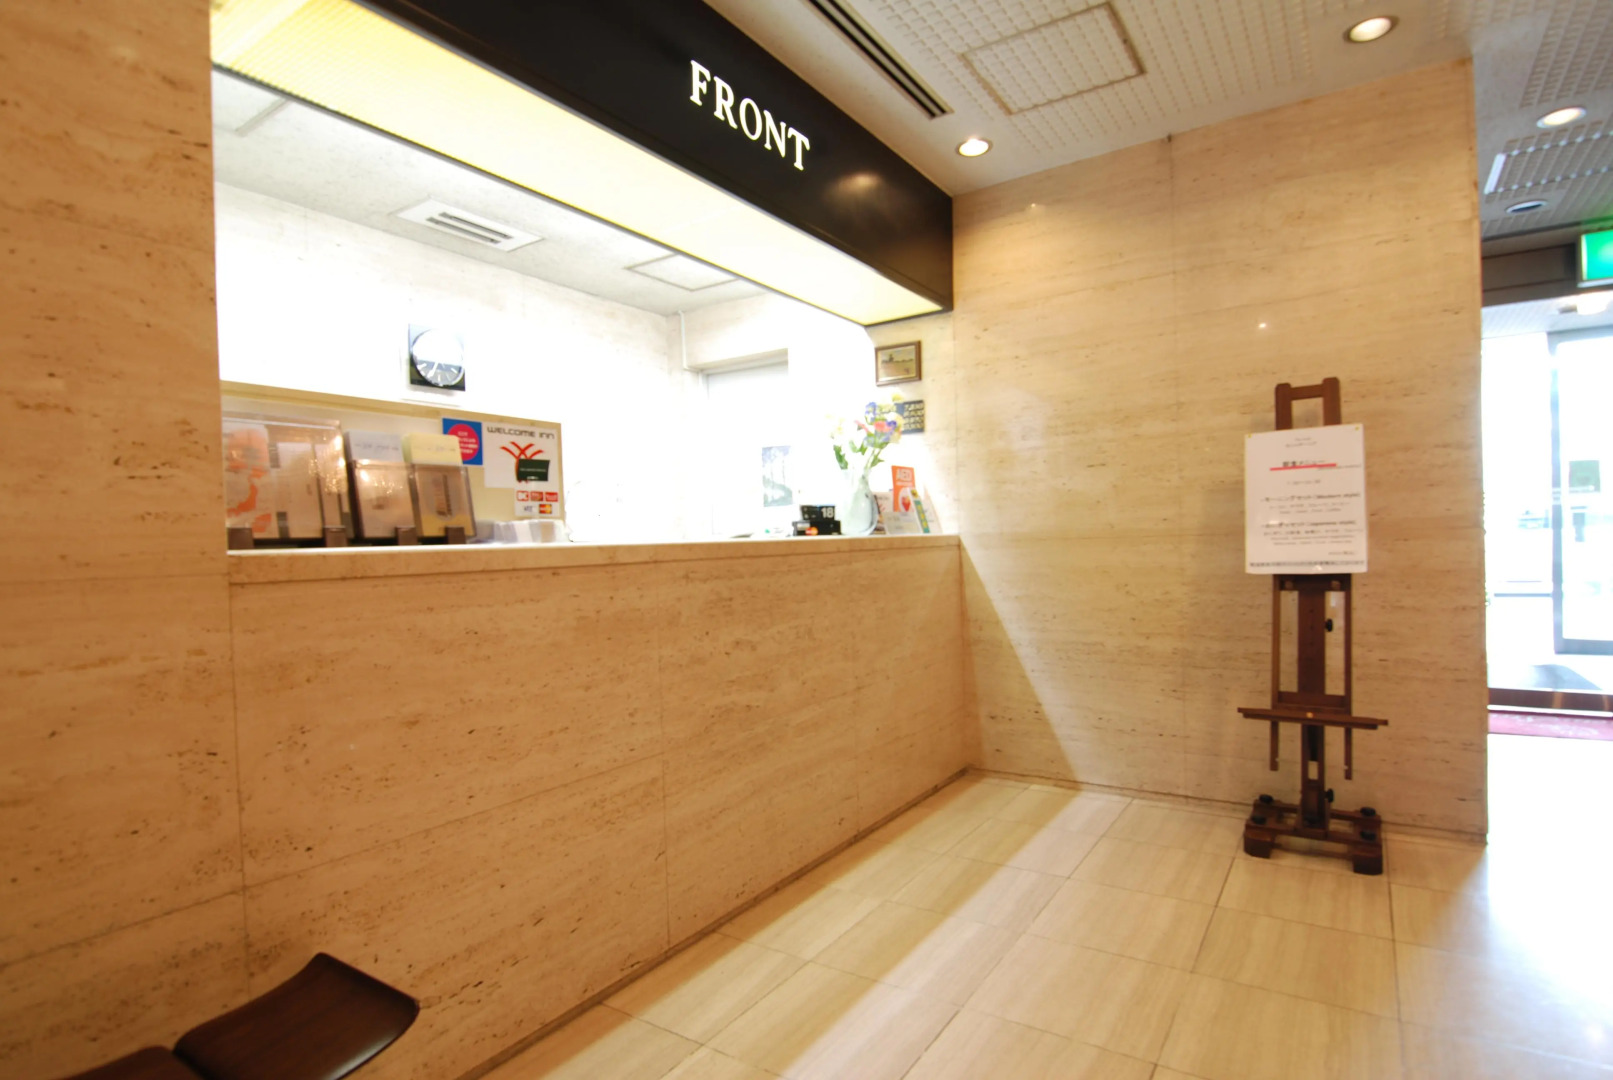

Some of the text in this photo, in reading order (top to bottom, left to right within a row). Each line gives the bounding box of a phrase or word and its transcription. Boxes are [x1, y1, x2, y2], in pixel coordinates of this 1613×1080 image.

[690, 59, 811, 171] FRONT
[487, 426, 535, 437] WELCOME
[895, 468, 912, 481] AED
[821, 507, 834, 518] 18
